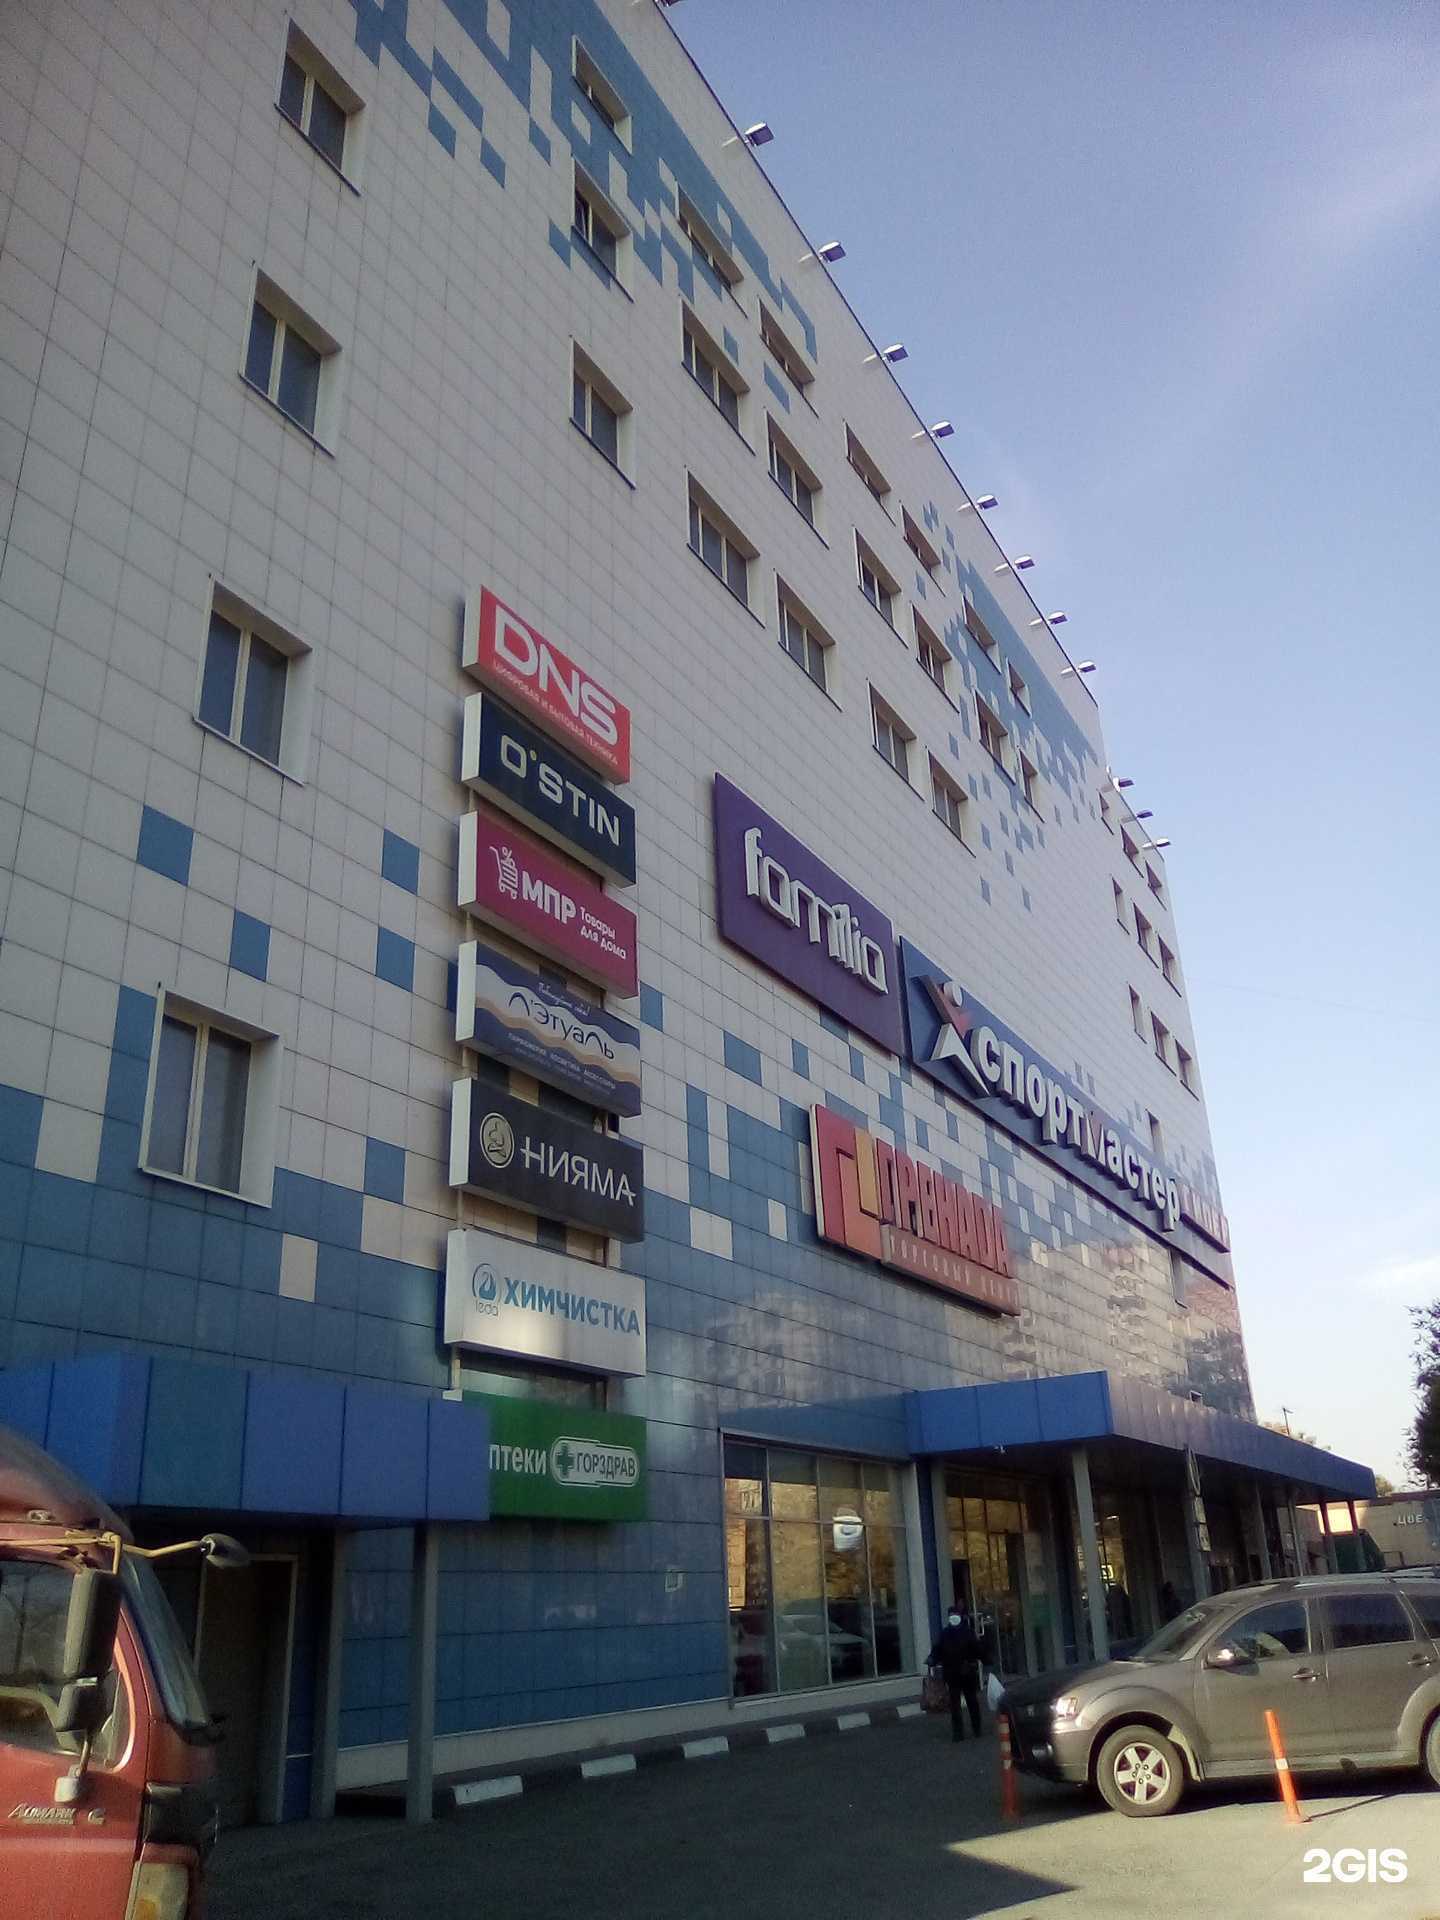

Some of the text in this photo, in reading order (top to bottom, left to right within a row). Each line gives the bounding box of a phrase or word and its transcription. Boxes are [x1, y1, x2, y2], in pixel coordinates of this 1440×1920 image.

[495, 603, 618, 746] DNS
[500, 734, 620, 847] O'STIN
[521, 870, 577, 925] МПР
[580, 906, 616, 940] Товары
[744, 826, 889, 995] familia
[520, 1135, 637, 1207] НИЯМА
[504, 1276, 641, 1336] ХИМЧИСТКА
[489, 1444, 547, 1475] птеки
[576, 1452, 636, 1480] ГОРЗДРАВ
